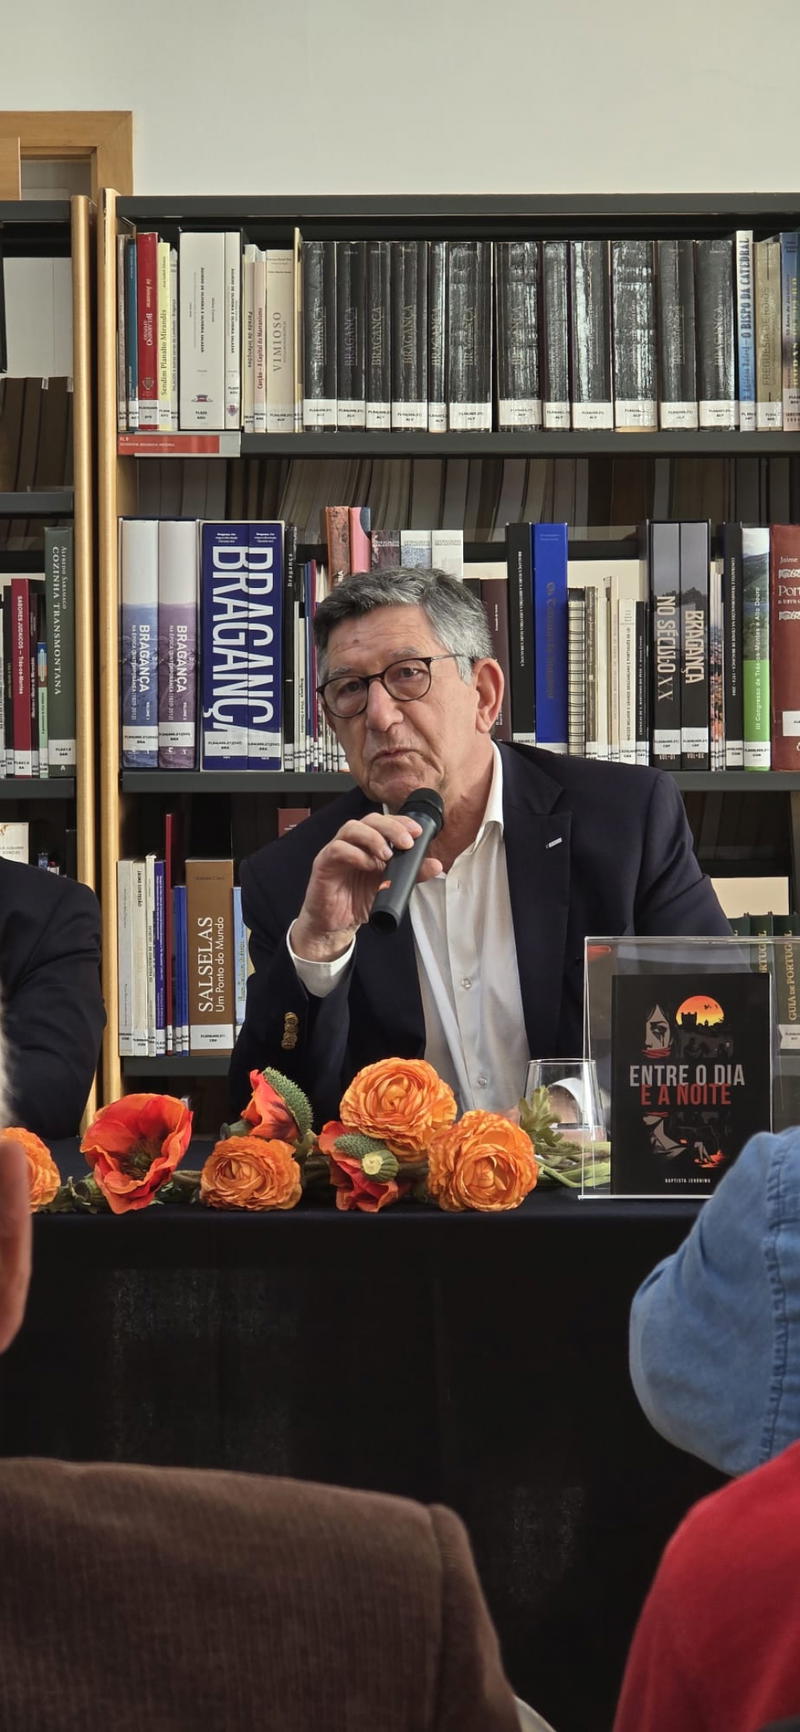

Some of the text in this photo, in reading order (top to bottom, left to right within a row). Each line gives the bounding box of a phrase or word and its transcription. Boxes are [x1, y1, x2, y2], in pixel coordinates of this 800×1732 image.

[739, 238, 750, 285] CATEDRAL
[740, 288, 751, 300] DA
[740, 303, 751, 329] BISPO
[160, 310, 168, 395] Sendim Planalto Mirandês
[273, 312, 282, 371] VIMIOSO
[371, 306, 384, 366] BRAGANÇA
[402, 304, 416, 364] BRAGANÇA
[432, 307, 442, 366] BRAGANÇA
[52, 547, 61, 695] COZINHA TRANSMONTANA
[657, 597, 675, 616] NO
[138, 625, 150, 692] BRAGANÇA
[175, 625, 188, 692] BRAGANÇA
[656, 620, 679, 672] SÉCULO
[681, 611, 705, 684] BRAGANÇA
[197, 917, 214, 1013] SALSELAS
[215, 917, 225, 1012] Um Ponto do Mundo
[783, 930, 796, 984] PORTUGL
[786, 996, 798, 1021] GUIA
[629, 1064, 746, 1087] ENTRE O DIA
[641, 1083, 732, 1105] E A NOITE
